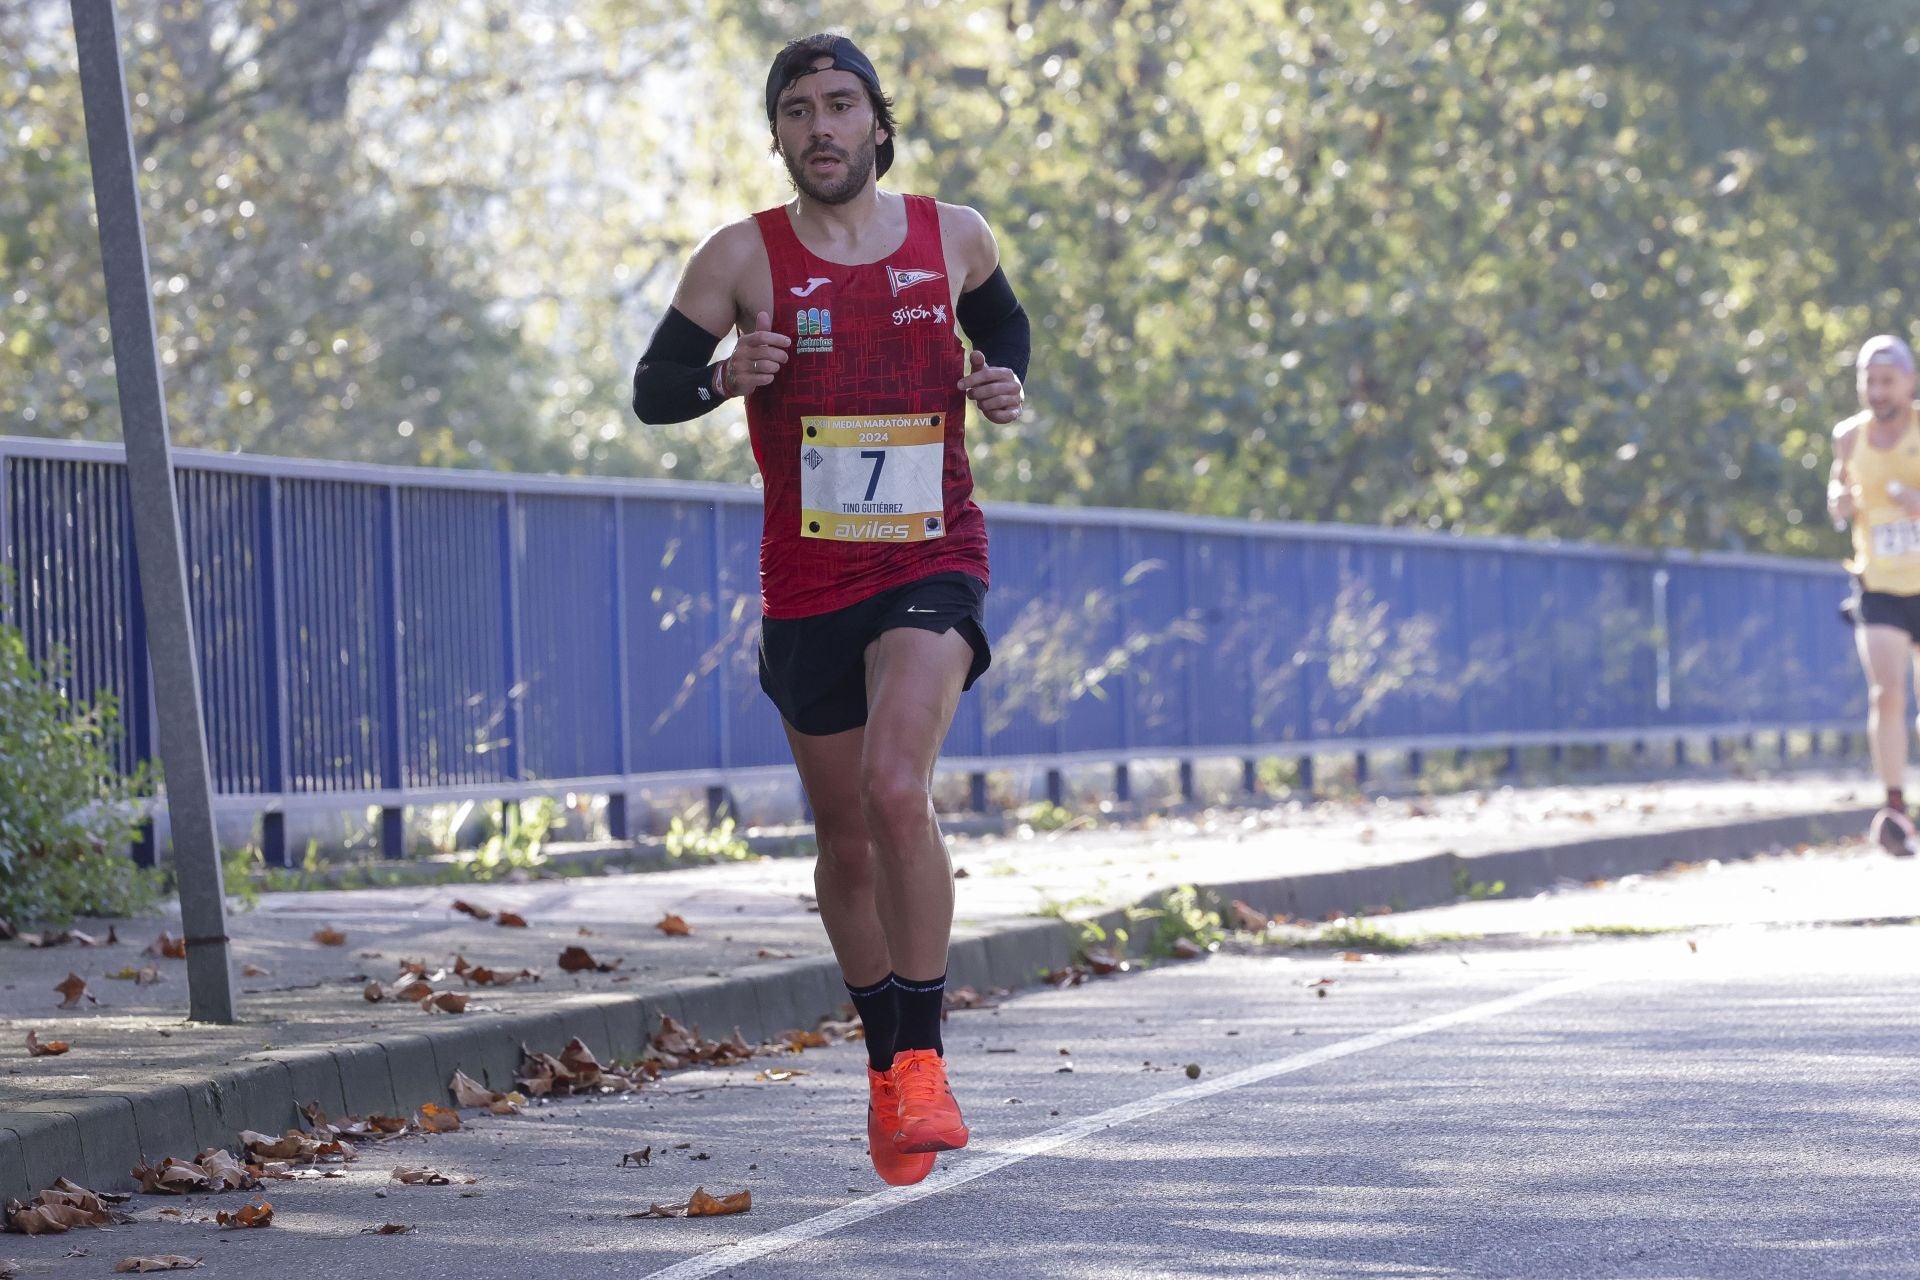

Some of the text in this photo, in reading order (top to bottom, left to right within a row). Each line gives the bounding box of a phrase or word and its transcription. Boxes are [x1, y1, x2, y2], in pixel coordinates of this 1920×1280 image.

[893, 304, 931, 326] gijón
[797, 336, 833, 347] Asturias
[832, 419, 861, 429] MEDIA
[864, 416, 910, 428] MARATÓN
[859, 432, 889, 443] 2024
[860, 450, 886, 502] 7
[842, 502, 904, 513] TINO GUTIÉRREZ
[834, 520, 910, 539] avilés
